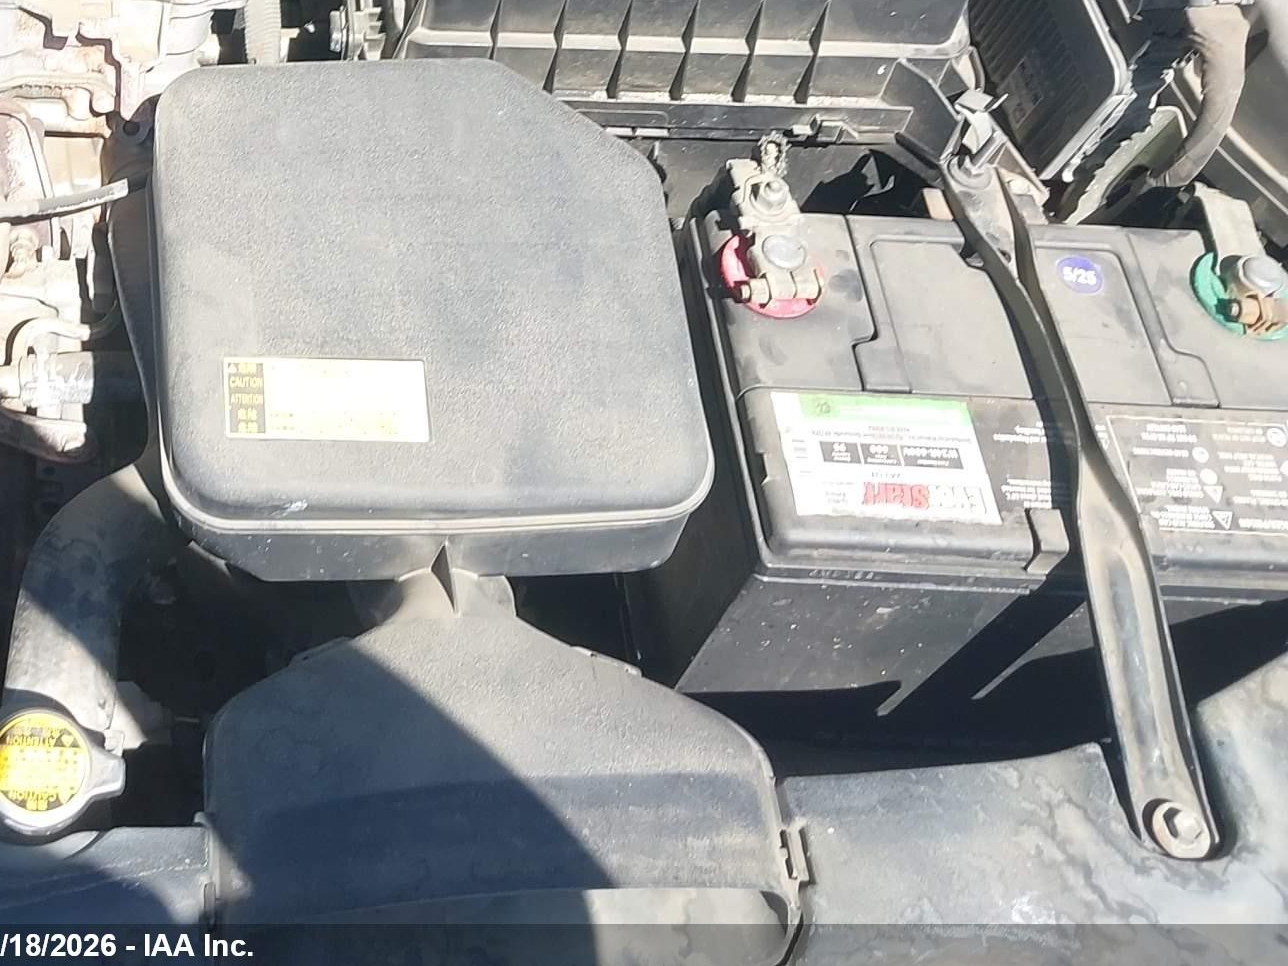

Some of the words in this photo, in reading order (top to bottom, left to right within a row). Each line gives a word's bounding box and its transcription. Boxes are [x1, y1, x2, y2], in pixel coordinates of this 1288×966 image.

[1062, 265, 1098, 286] 5/25
[229, 376, 264, 388] CAUTION
[230, 393, 264, 405] ATTENTION
[863, 481, 988, 514] EveStart
[6, 734, 57, 747] ATTENTION
[8, 791, 57, 802] CAUTION
